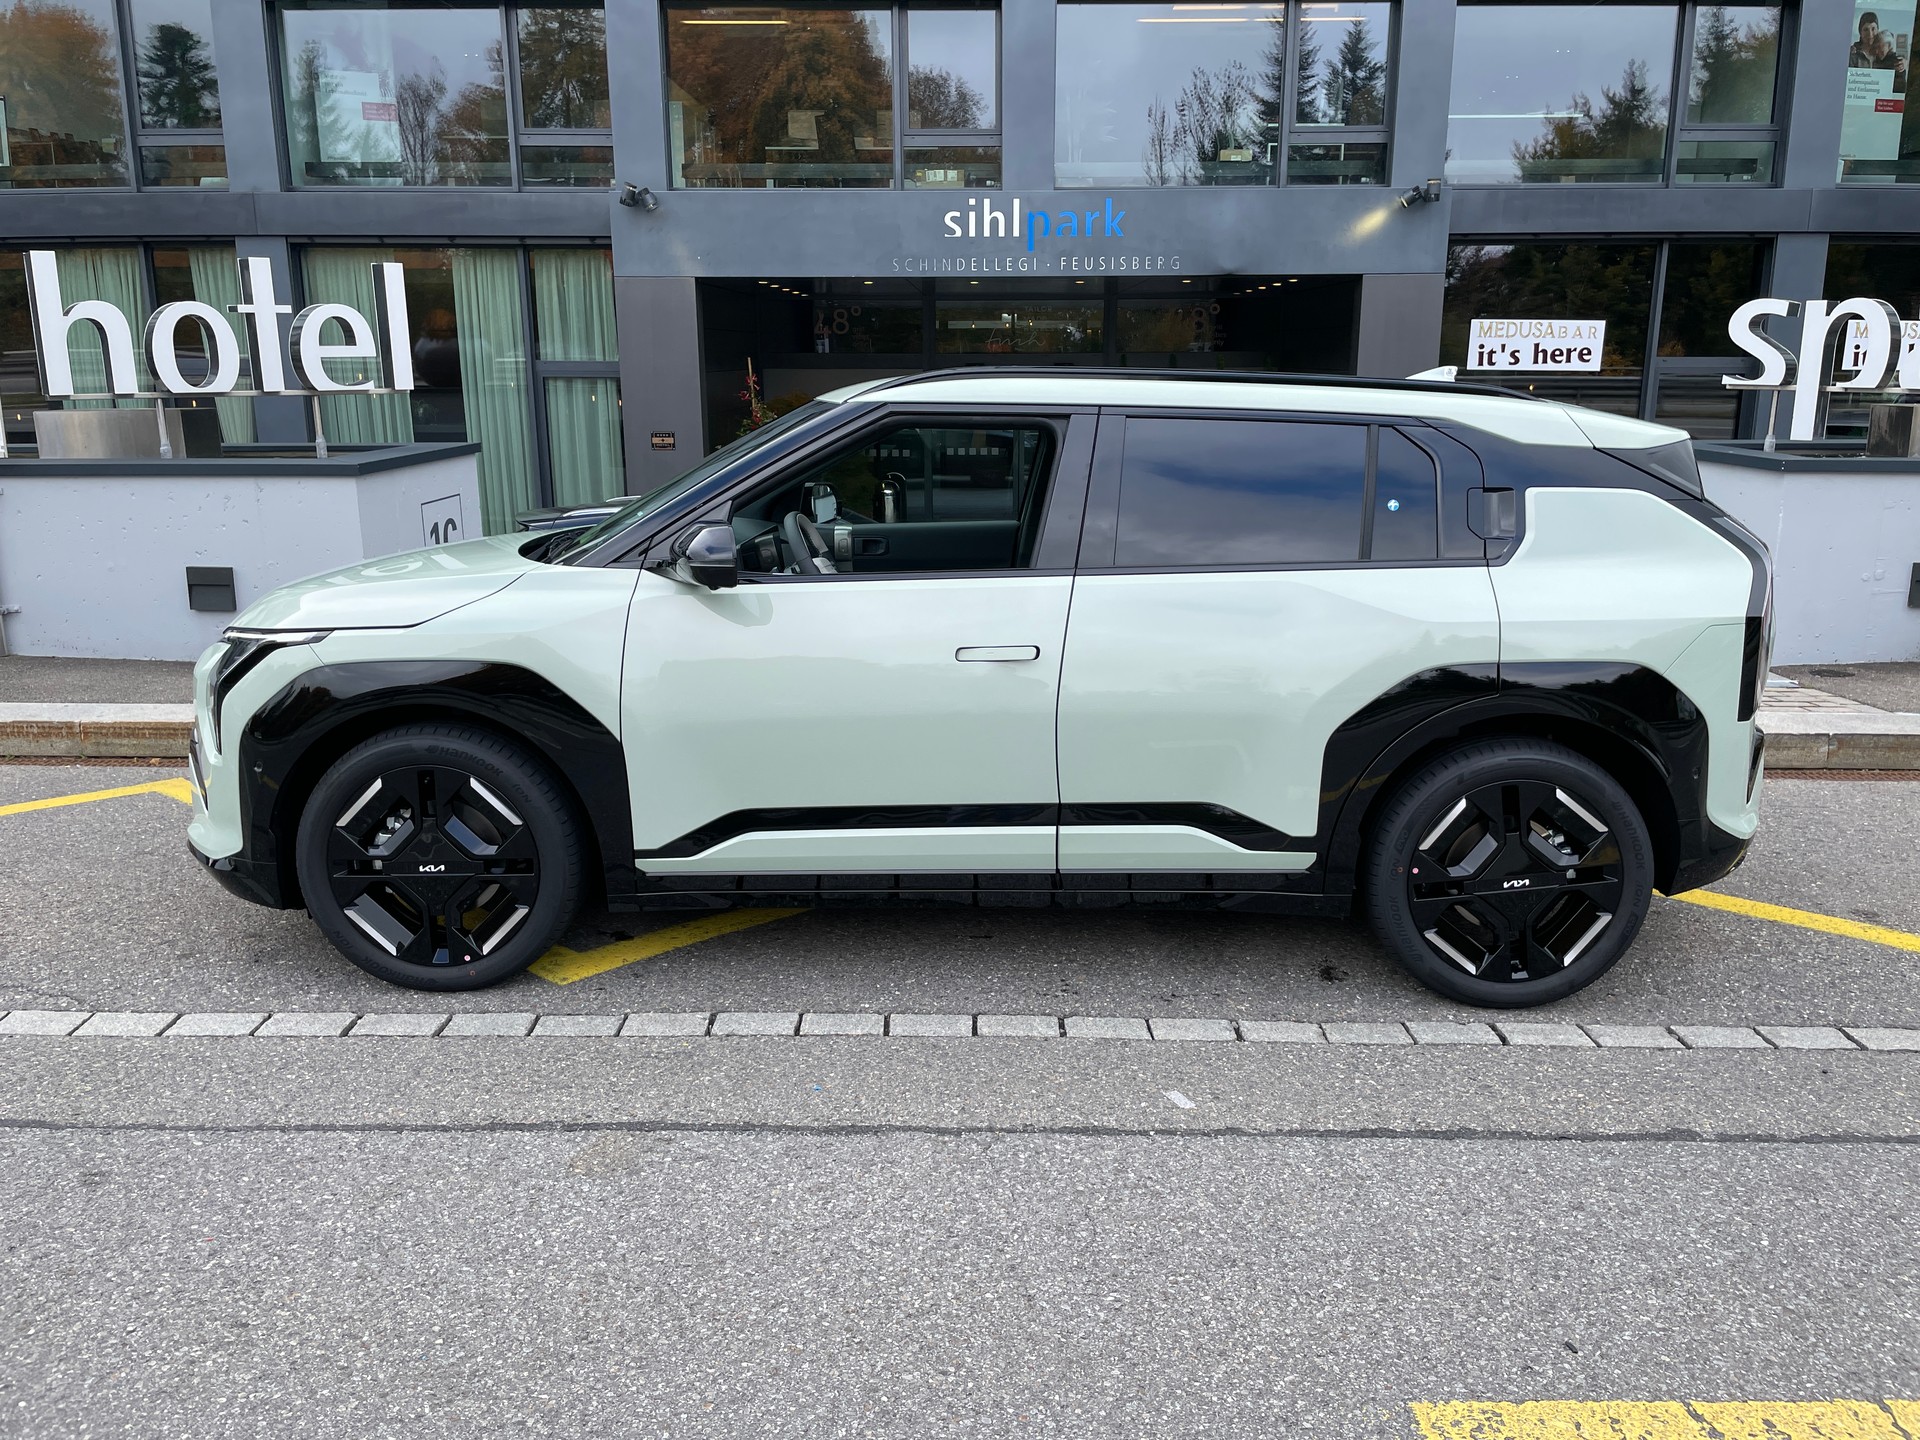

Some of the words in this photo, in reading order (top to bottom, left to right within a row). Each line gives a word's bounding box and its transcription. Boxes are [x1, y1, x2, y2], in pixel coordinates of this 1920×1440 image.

[943, 197, 1127, 253] sihlpark
[892, 256, 1038, 272] SCHINDELLEGI
[1060, 255, 1181, 271] FEUSISBERG
[24, 249, 416, 398] hotel
[1477, 320, 1556, 339] MEDUSA
[1476, 343, 1521, 367] it's
[1533, 342, 1592, 365] here
[1722, 297, 1920, 441] sp
